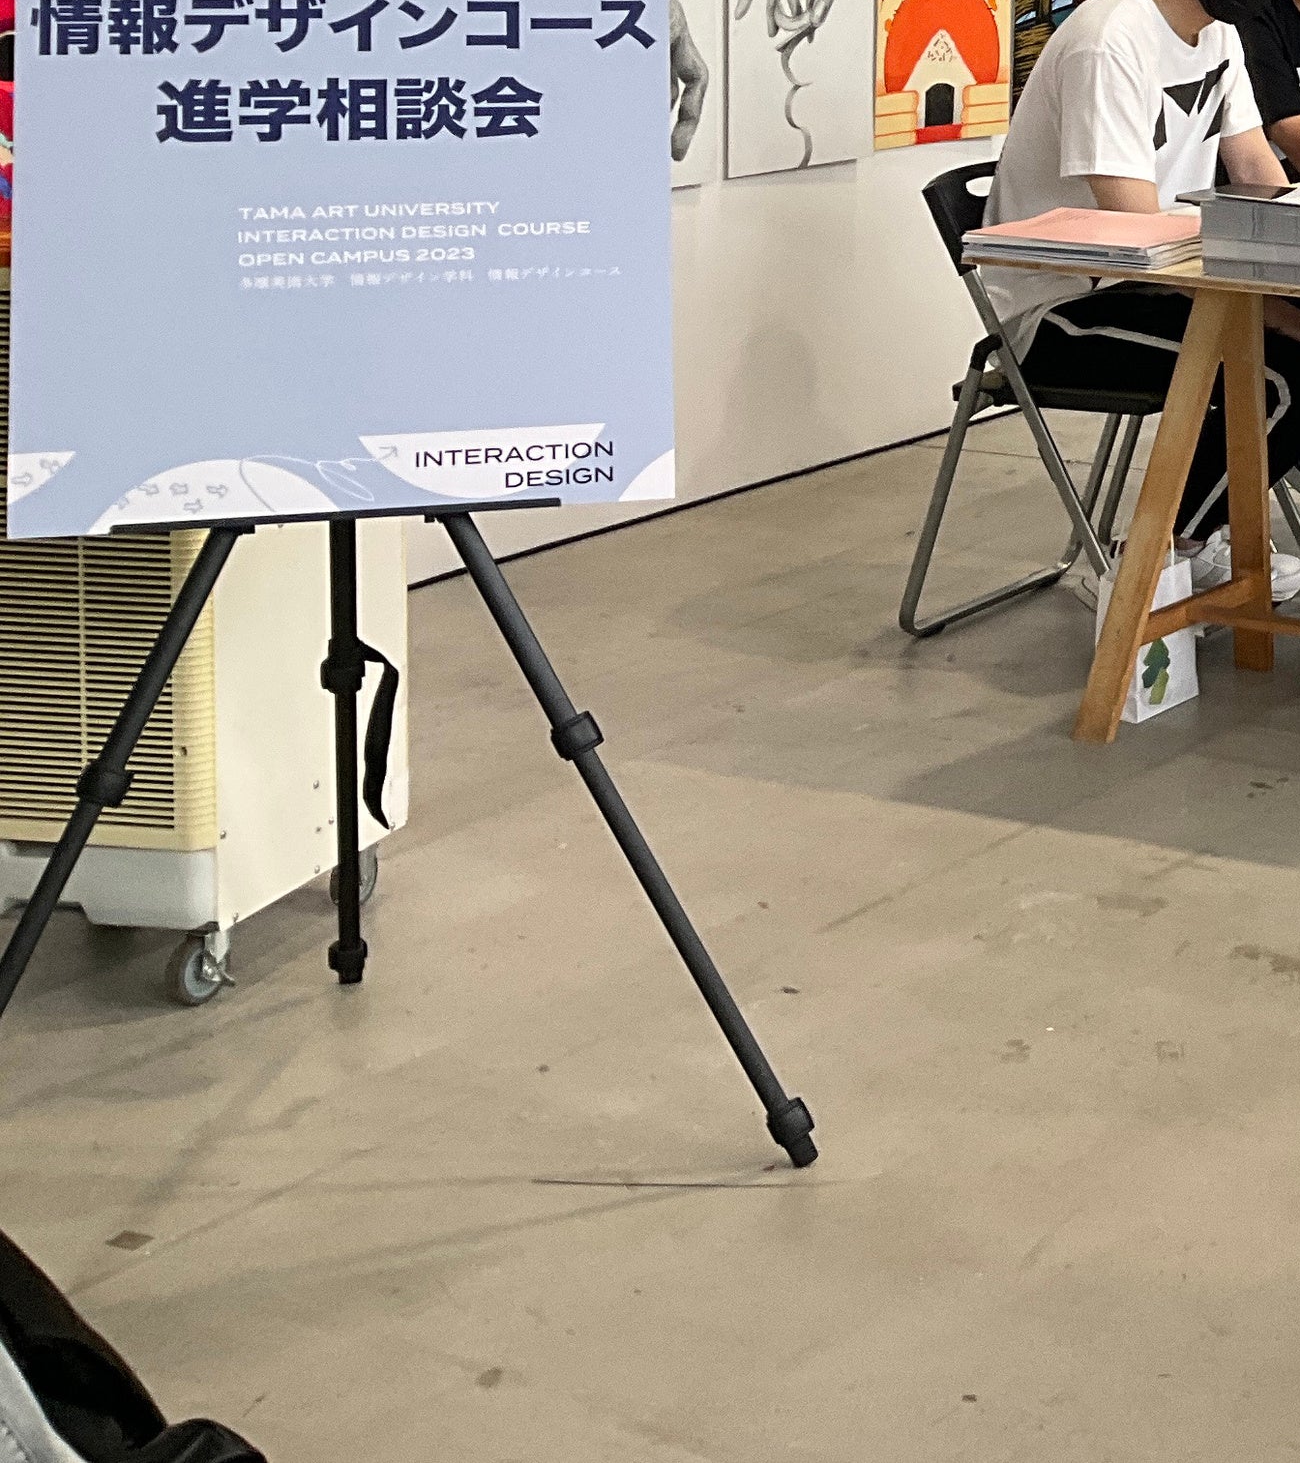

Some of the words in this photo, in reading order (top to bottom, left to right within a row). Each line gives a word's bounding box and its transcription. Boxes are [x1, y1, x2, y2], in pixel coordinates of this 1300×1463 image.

[156, 76, 545, 146] 進学相談会
[239, 205, 306, 220] TAMA
[311, 204, 359, 219] ART
[364, 201, 500, 218] UNIVERSITY
[238, 226, 395, 243] INTERACTION
[401, 223, 487, 240] DESIGN
[497, 221, 591, 237] COURSE
[238, 252, 305, 267] OPEN
[310, 249, 411, 266] CAMPUS
[415, 247, 476, 262] 2023
[415, 441, 614, 468] INTERACTION
[505, 466, 614, 488] DESIGN
